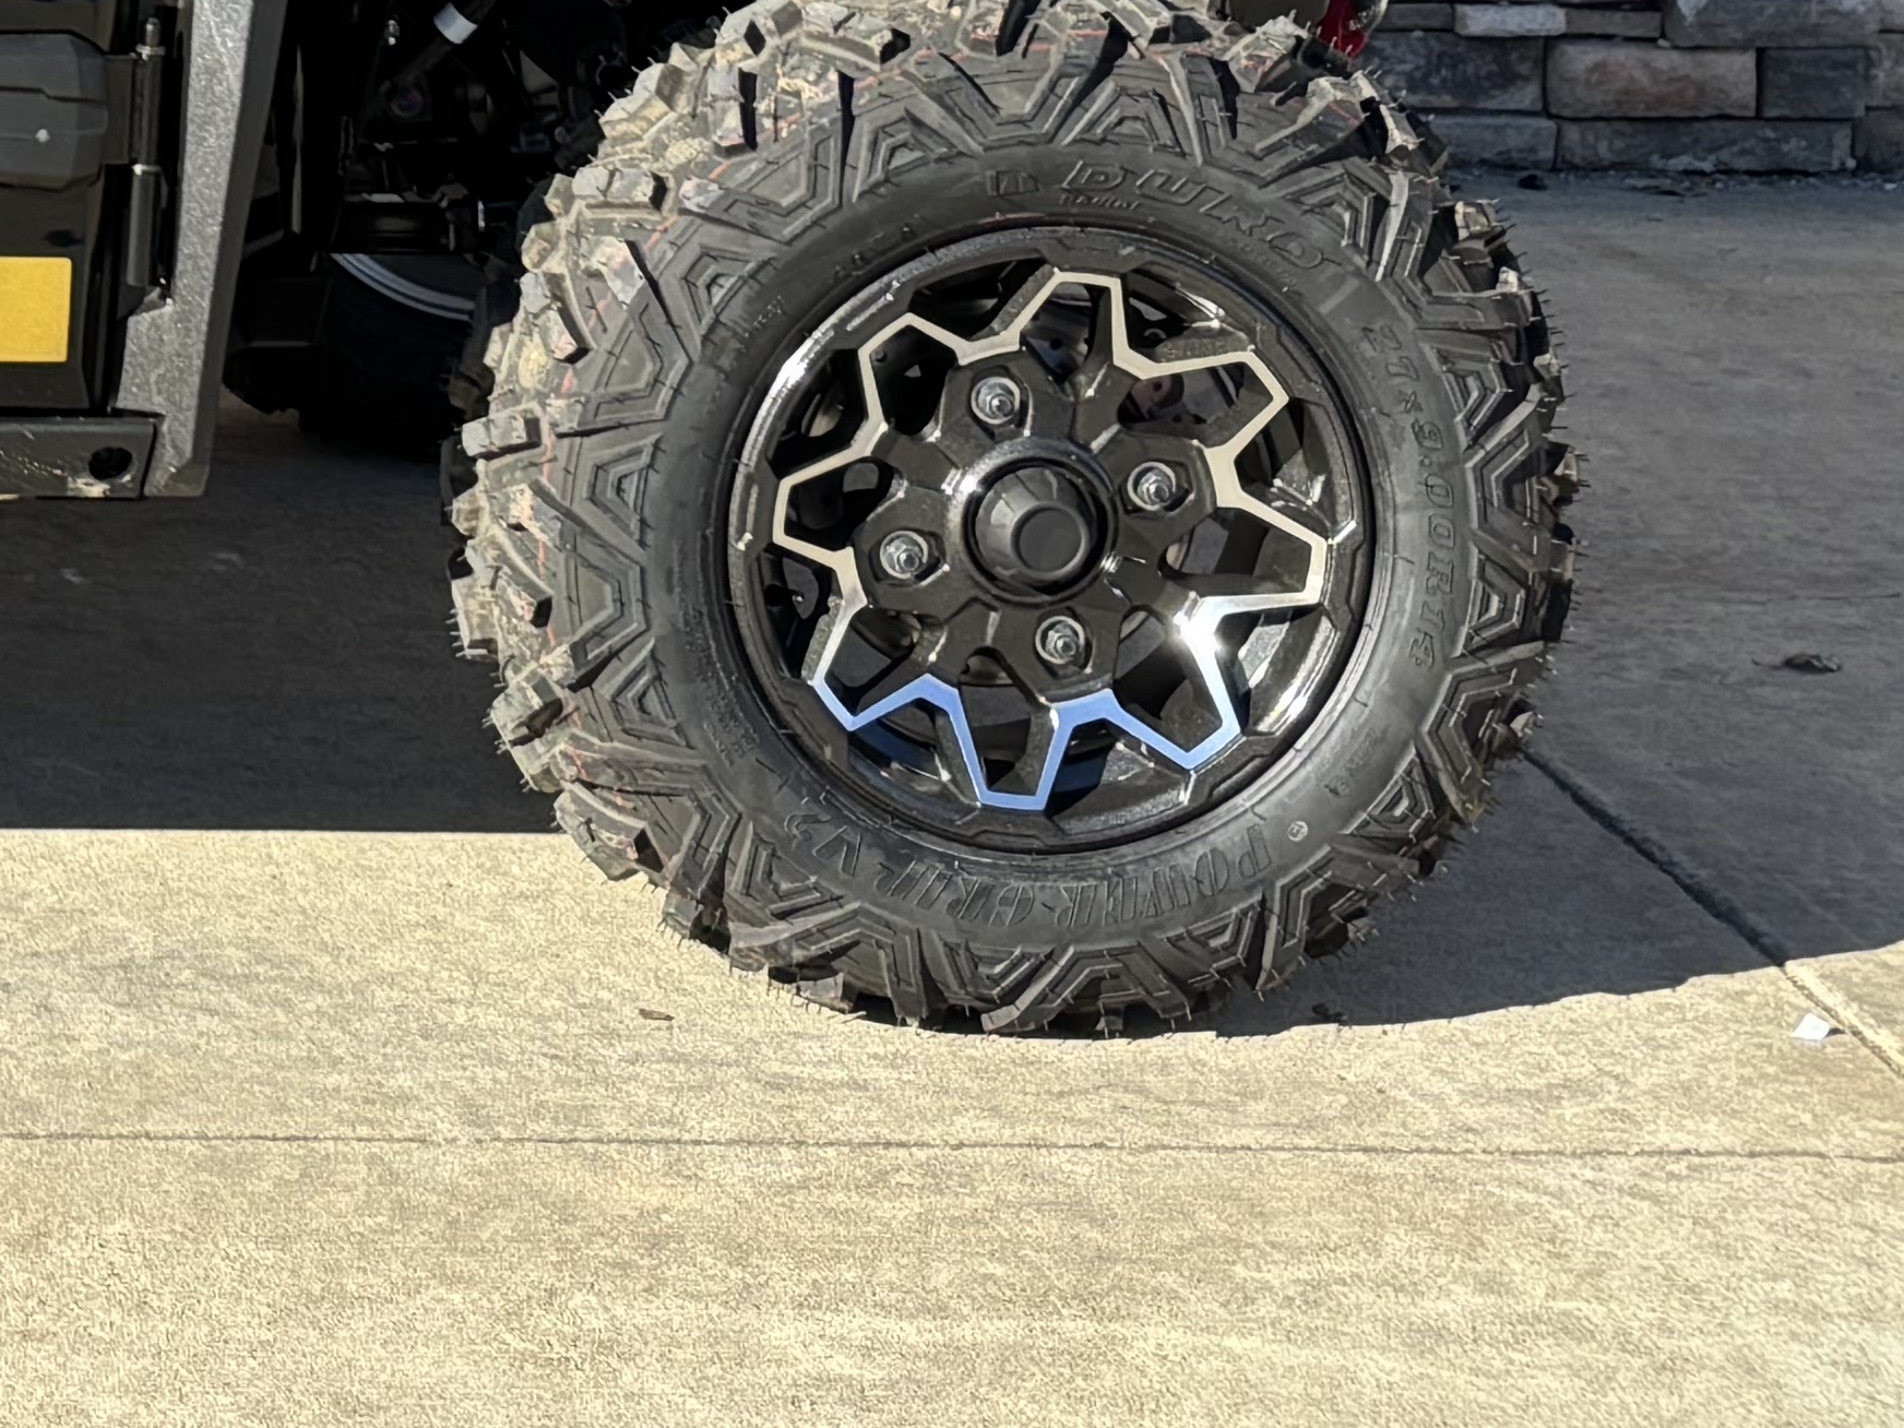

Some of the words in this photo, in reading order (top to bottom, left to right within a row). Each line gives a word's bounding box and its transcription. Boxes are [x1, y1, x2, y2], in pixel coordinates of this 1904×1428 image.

[1060, 160, 1324, 270] DURO
[782, 808, 866, 880] V2
[870, 852, 1033, 930] GRIP
[1054, 818, 1278, 934] POWER
